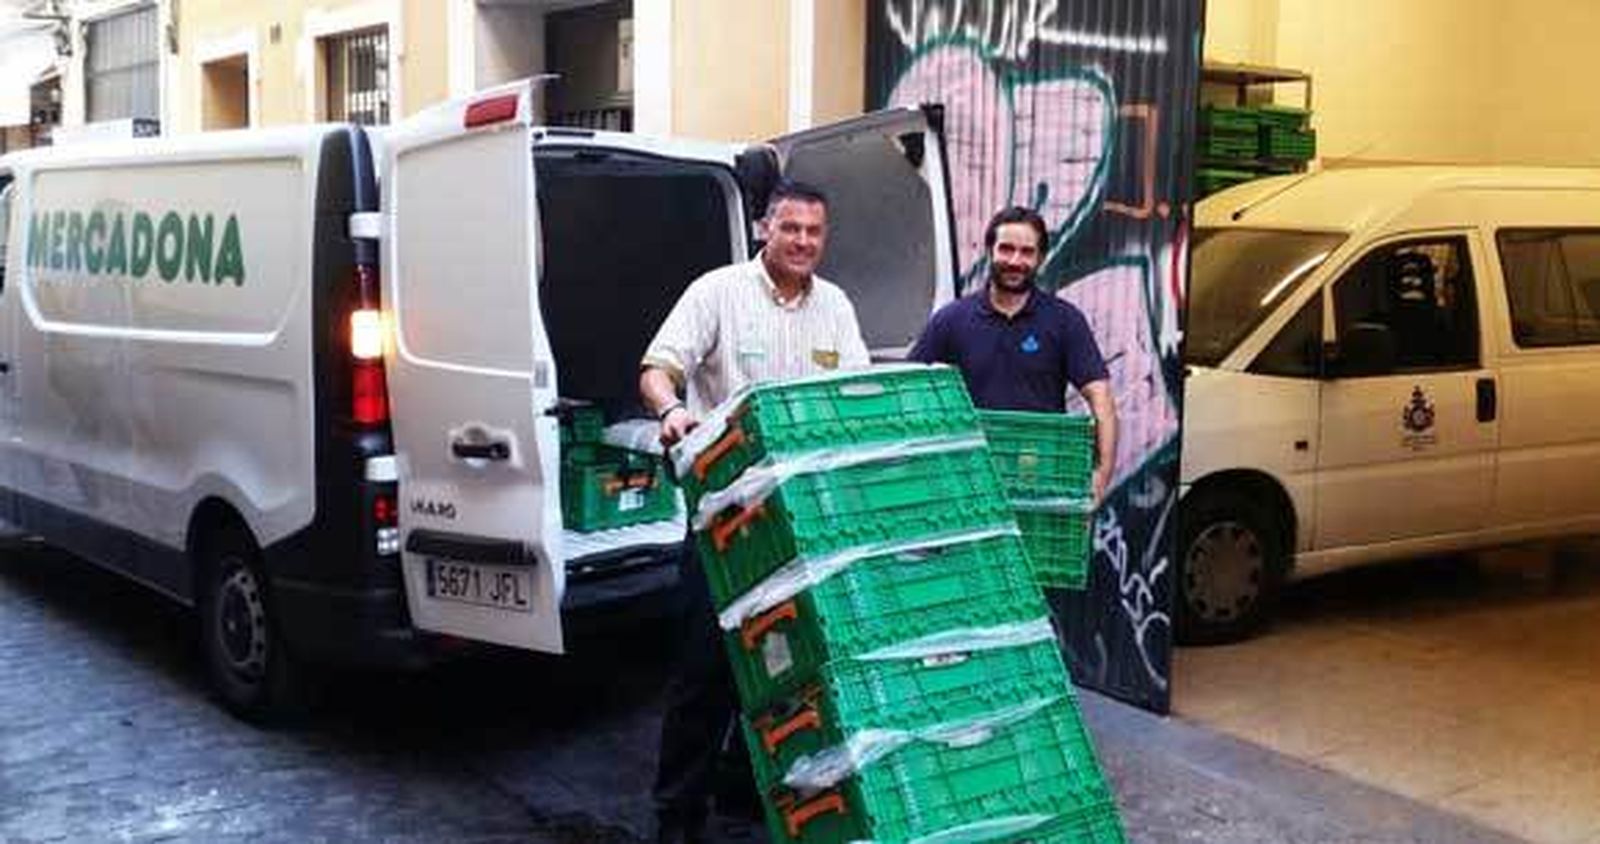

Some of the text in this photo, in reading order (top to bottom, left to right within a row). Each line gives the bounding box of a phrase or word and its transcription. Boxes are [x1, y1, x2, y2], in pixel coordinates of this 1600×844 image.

[27, 210, 245, 286] MERCADONA
[438, 564, 527, 606] 5671 JFL
